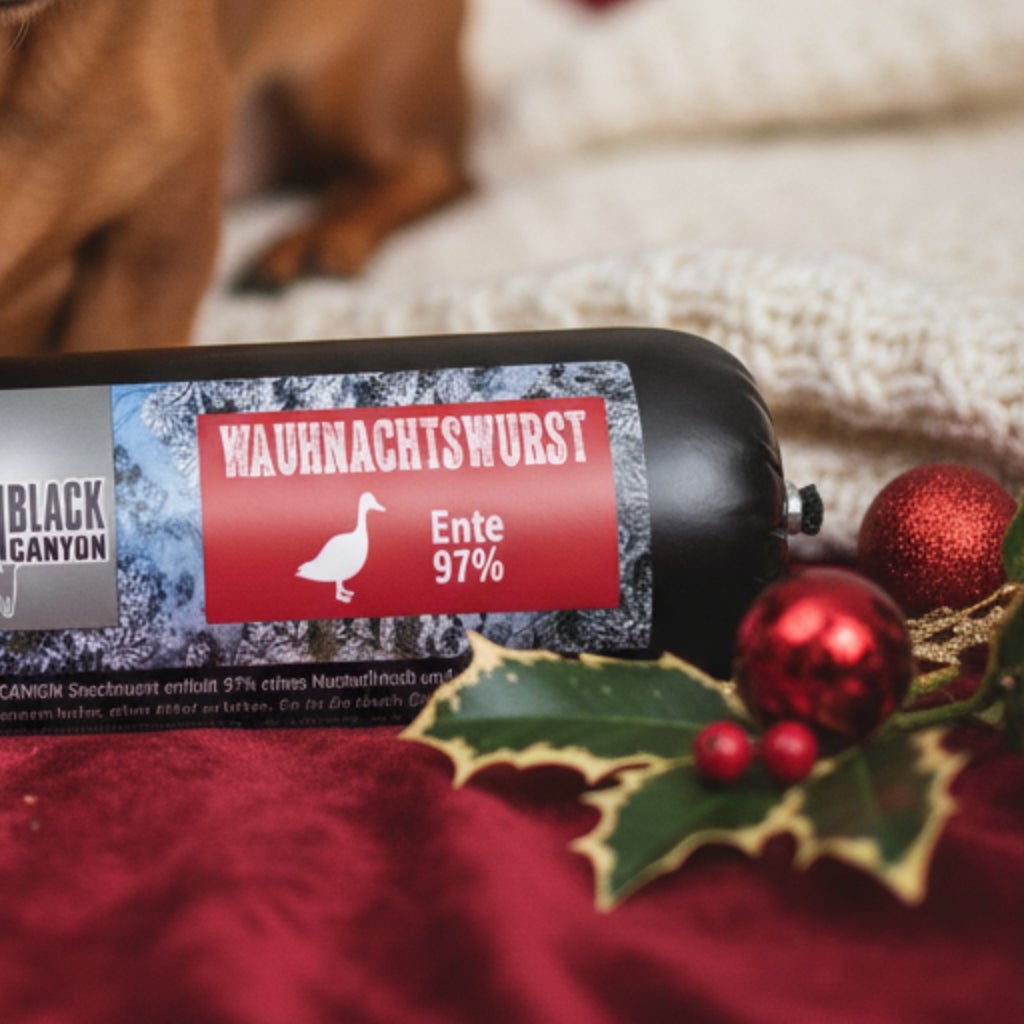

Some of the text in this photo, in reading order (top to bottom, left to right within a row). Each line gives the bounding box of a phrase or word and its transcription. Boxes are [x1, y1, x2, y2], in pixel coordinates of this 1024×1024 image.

[220, 410, 587, 478] WAUHNACHTSWURST
[8, 480, 105, 533] BLACK
[431, 509, 505, 545] Ente
[9, 534, 107, 563] CANYON
[433, 547, 505, 584] 97%
